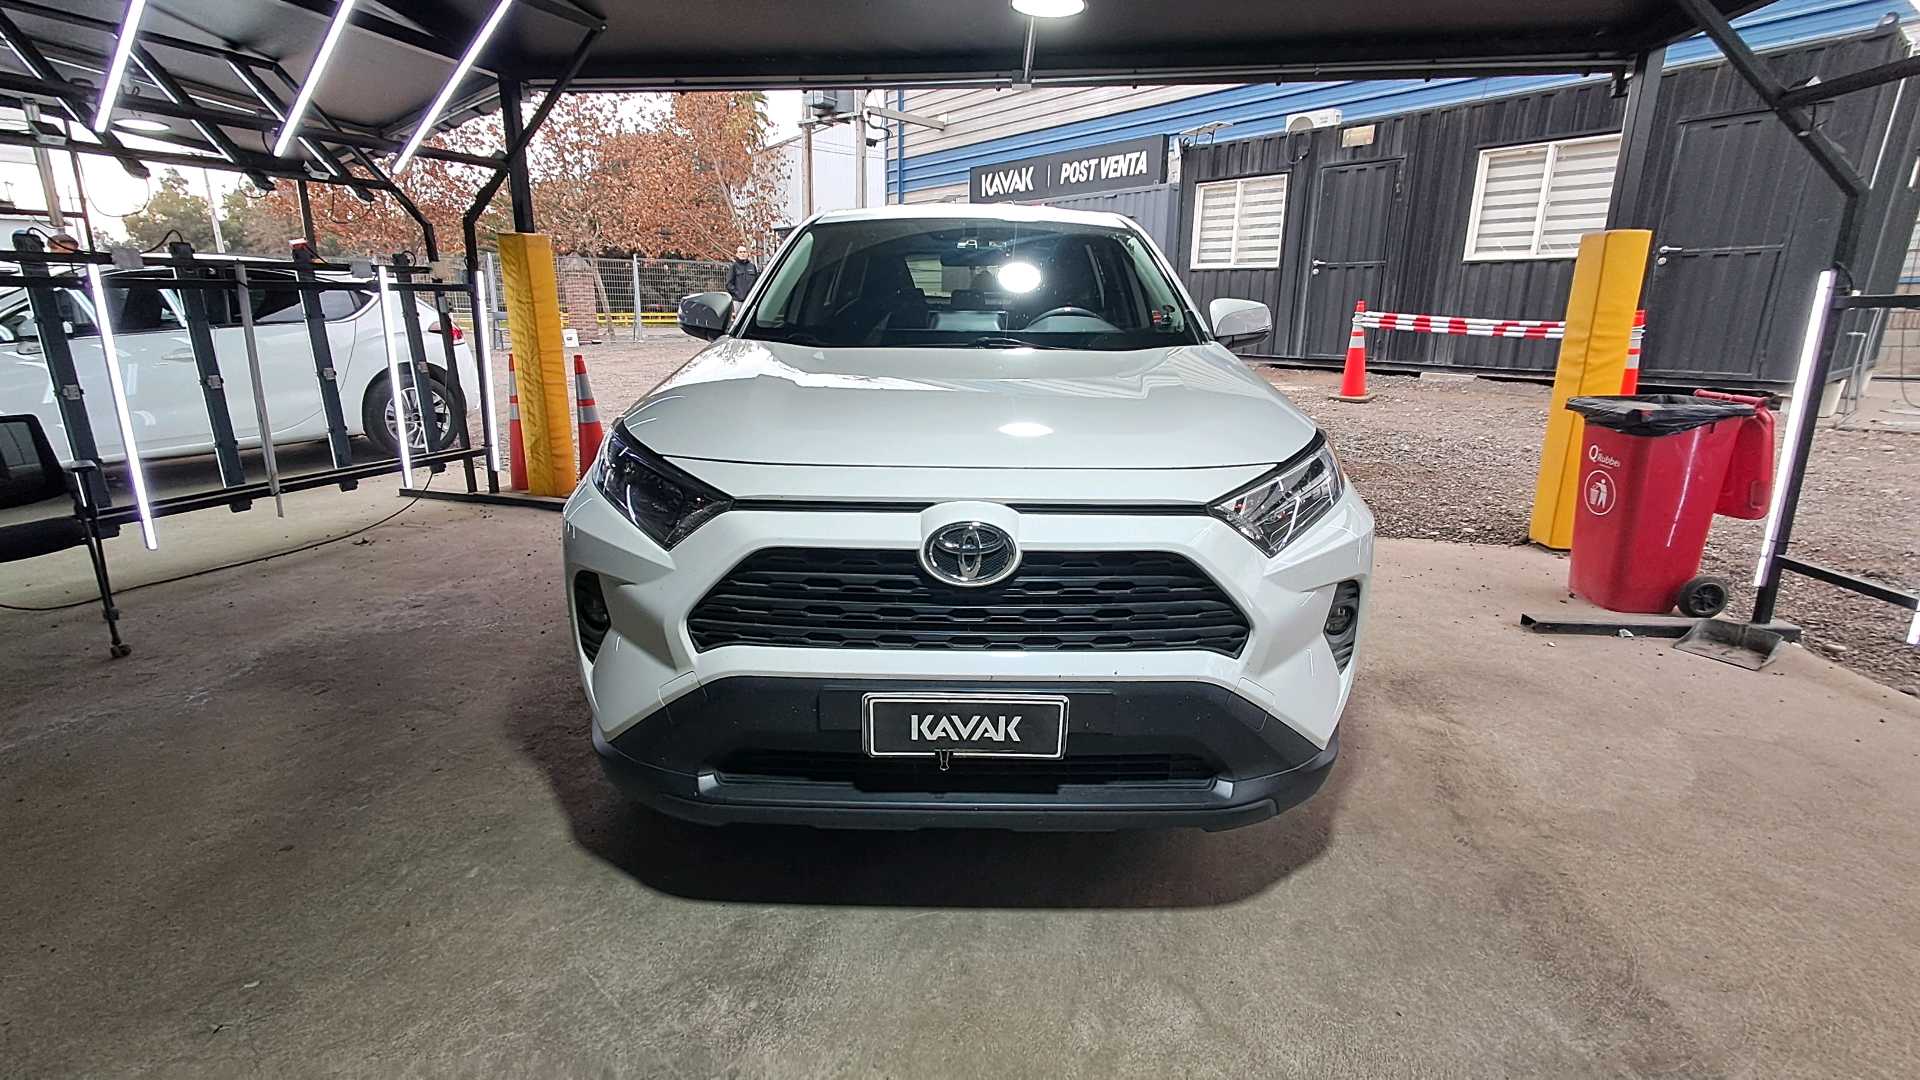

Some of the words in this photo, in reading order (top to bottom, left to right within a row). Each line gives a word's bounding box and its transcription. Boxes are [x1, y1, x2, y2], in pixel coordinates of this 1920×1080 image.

[981, 166, 1034, 197] KAVAK
[1060, 158, 1098, 184] POST
[1100, 151, 1148, 179] VENTA
[911, 714, 1022, 742] KAVAK
